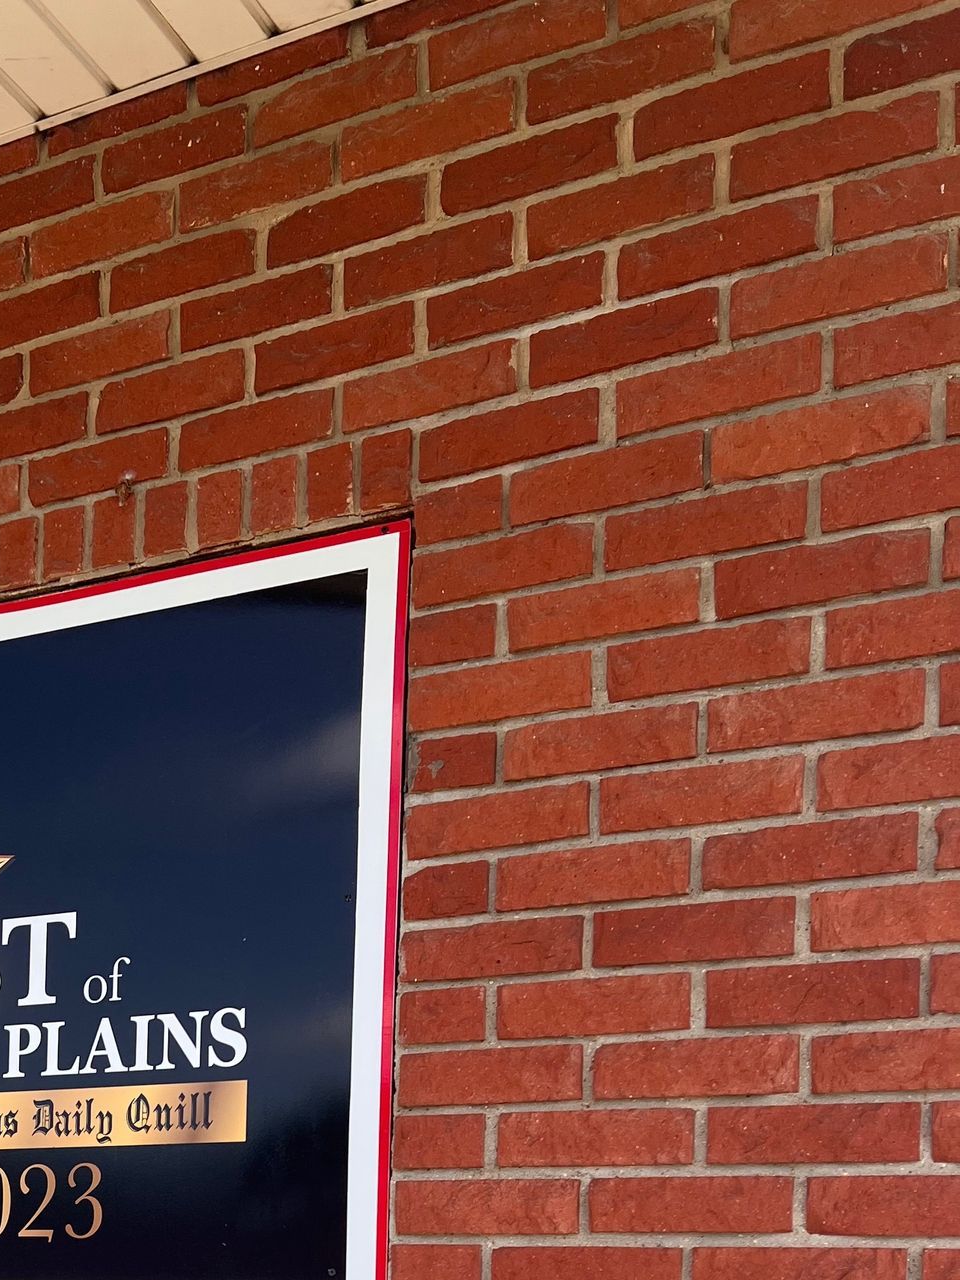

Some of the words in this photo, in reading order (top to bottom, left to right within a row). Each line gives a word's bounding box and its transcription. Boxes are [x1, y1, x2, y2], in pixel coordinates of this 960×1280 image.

[83, 957, 130, 1004] of
[3, 1007, 247, 1078] PLAINS
[32, 1098, 114, 1144] Daily
[127, 1091, 214, 1135] Quill
